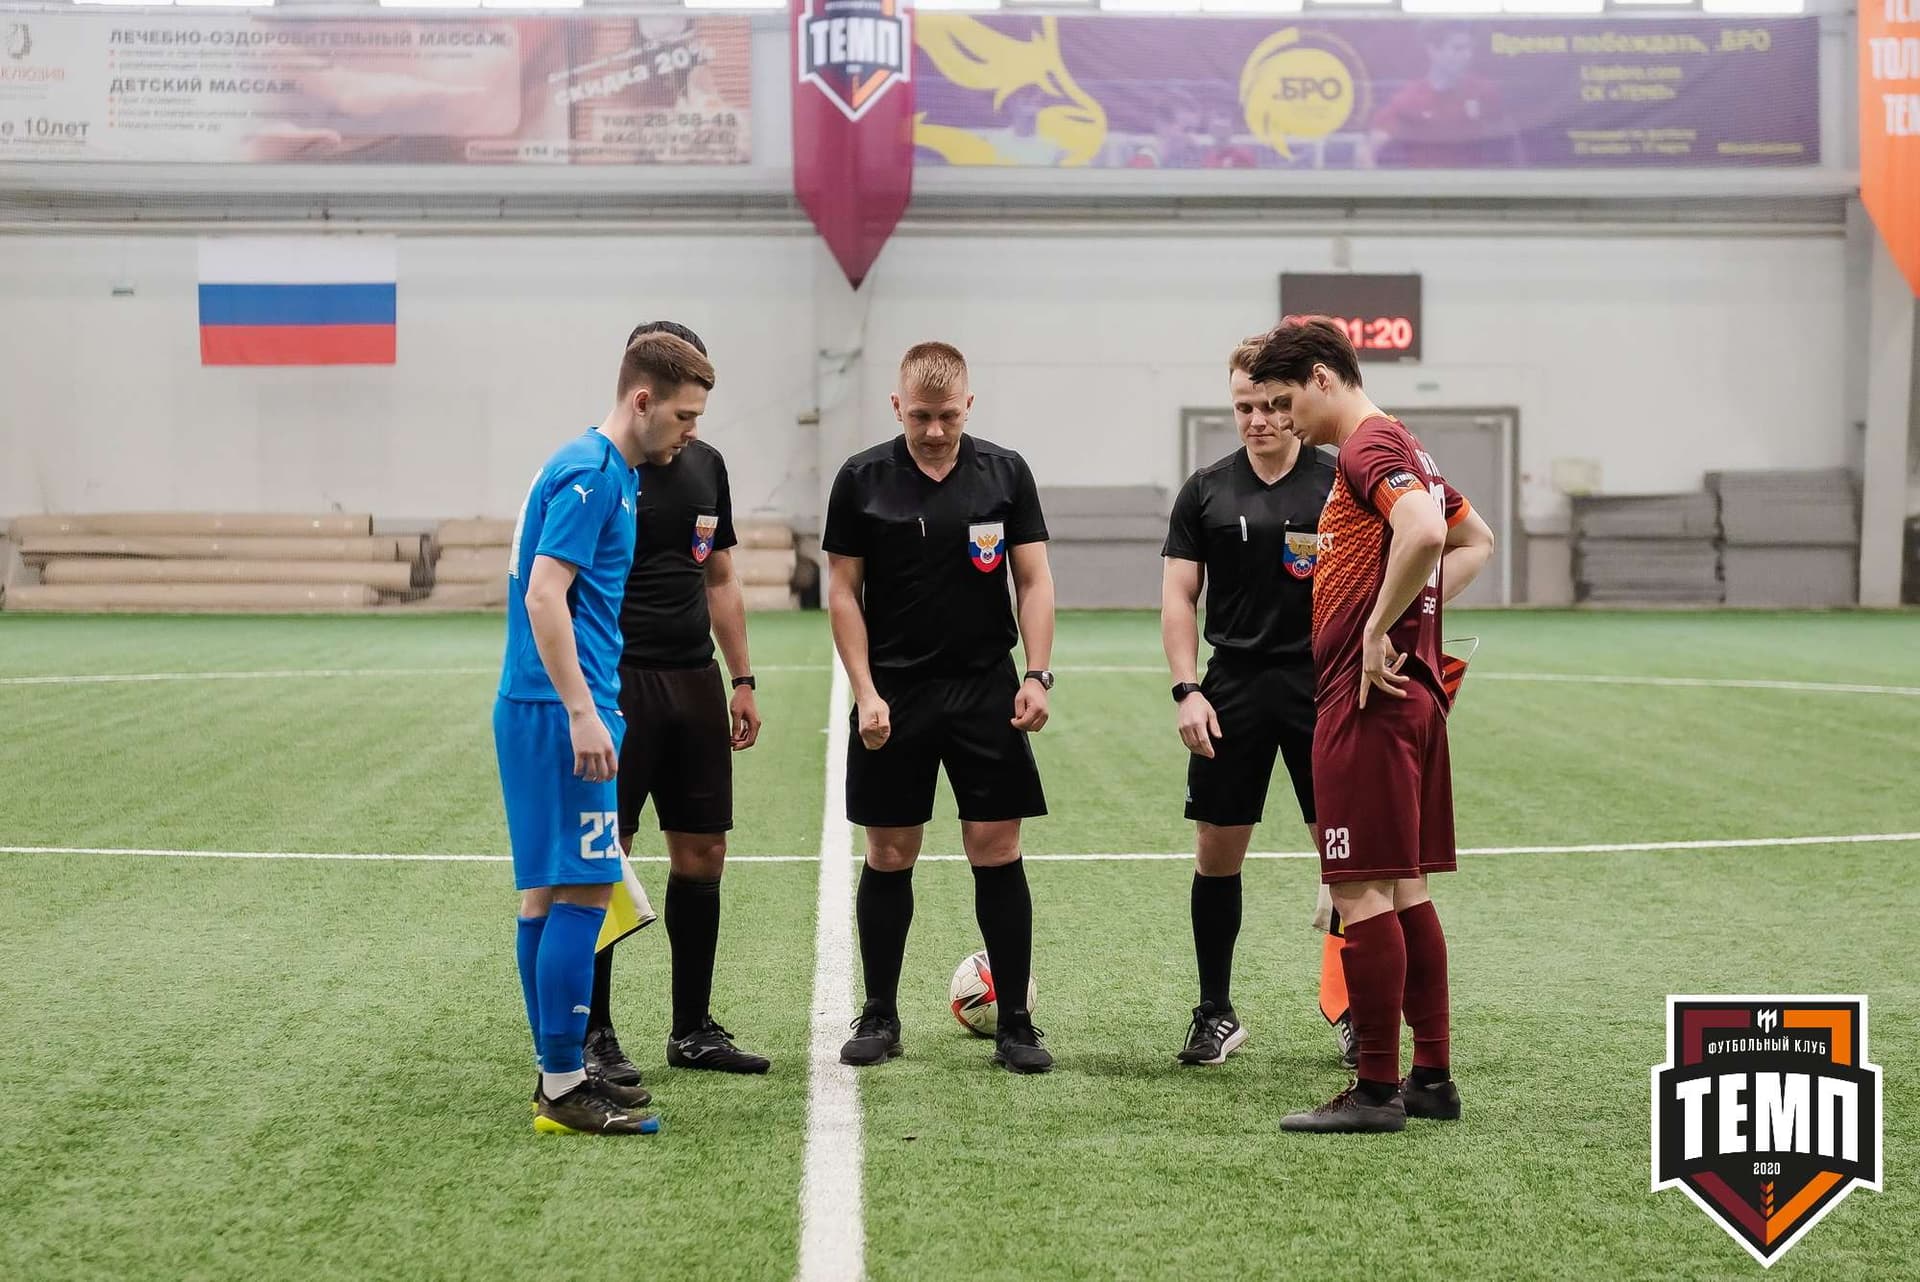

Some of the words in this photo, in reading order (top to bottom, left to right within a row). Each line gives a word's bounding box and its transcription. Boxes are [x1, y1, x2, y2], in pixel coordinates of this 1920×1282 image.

[809, 18, 899, 66] ТЕМП
[110, 78, 202, 94] ДЕТСКИЙ
[24, 117, 91, 137] 10лет
[1325, 827, 1350, 860] 23
